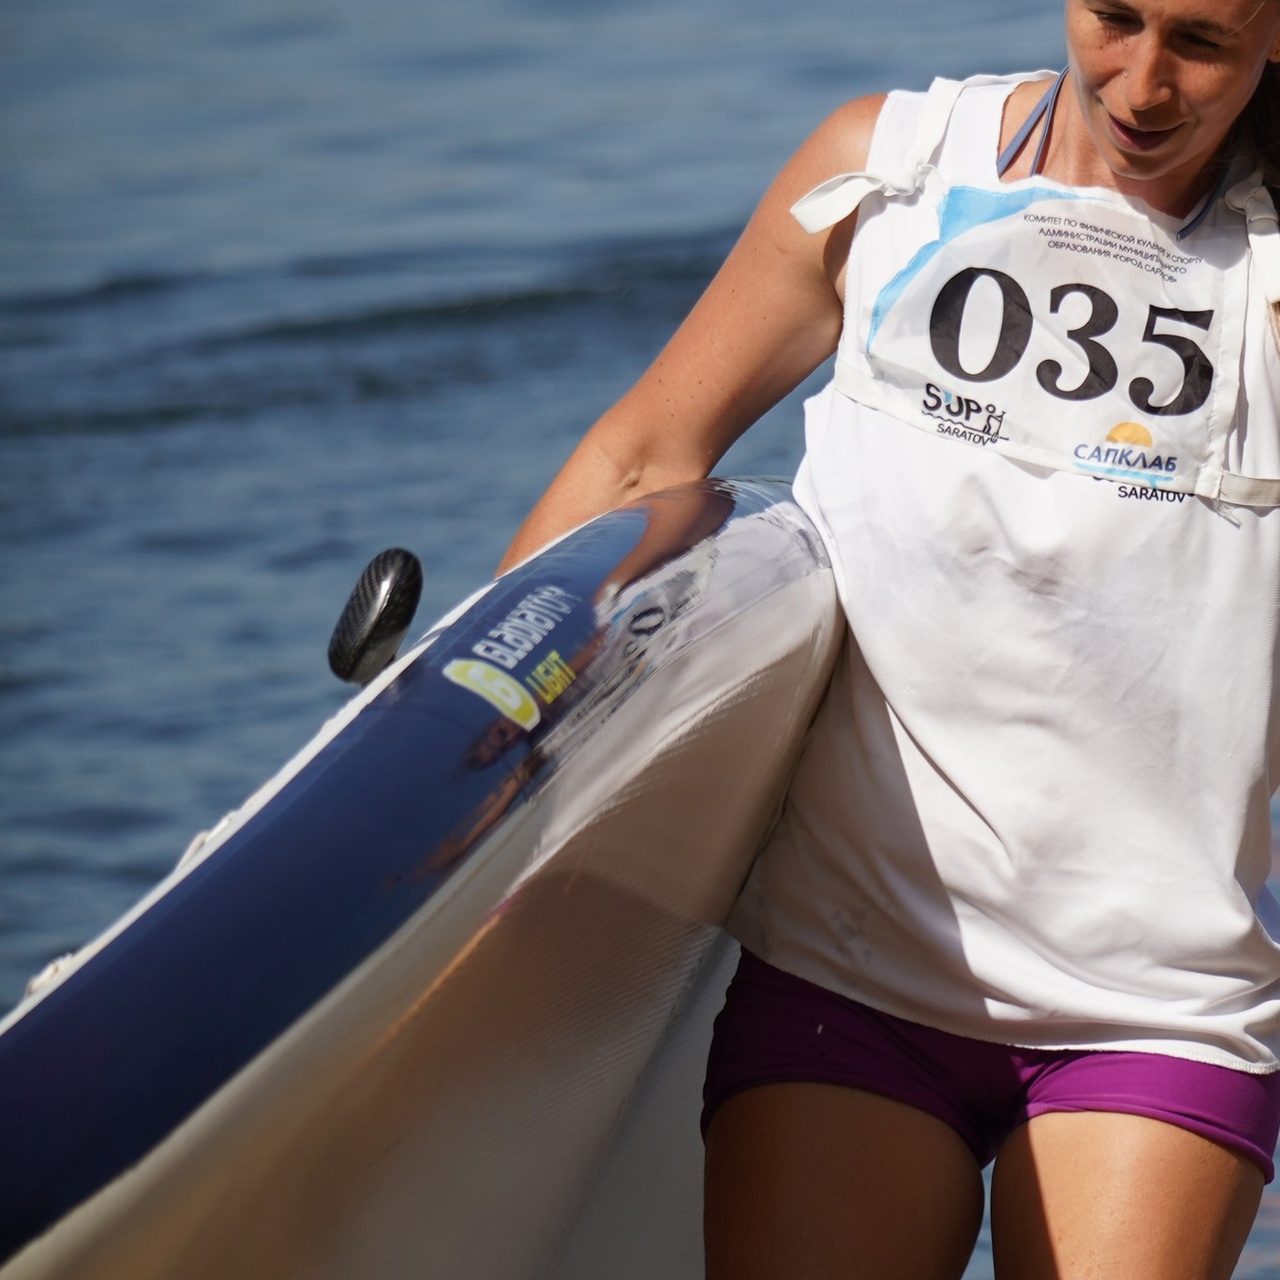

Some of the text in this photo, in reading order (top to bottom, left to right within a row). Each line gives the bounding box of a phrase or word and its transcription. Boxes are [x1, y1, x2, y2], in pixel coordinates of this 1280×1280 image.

[1023, 213, 1063, 226] КОМИТЕТ
[1064, 218, 1077, 228] ПО
[1079, 222, 1135, 243] ФИЗИЧЕСКОЙ
[1171, 254, 1205, 265] СПОРТУ
[1038, 227, 1118, 250] АДМИНИСТРАЦИИ
[1047, 240, 1111, 258] ОБРАЗОВАНИЯ
[930, 267, 1215, 417] 035
[922, 383, 982, 422] SUP
[936, 423, 990, 446] SARATOV
[1073, 443, 1178, 472] САПКЛАБ
[1118, 485, 1186, 503] SARATOV
[524, 649, 576, 705] LIGHT
